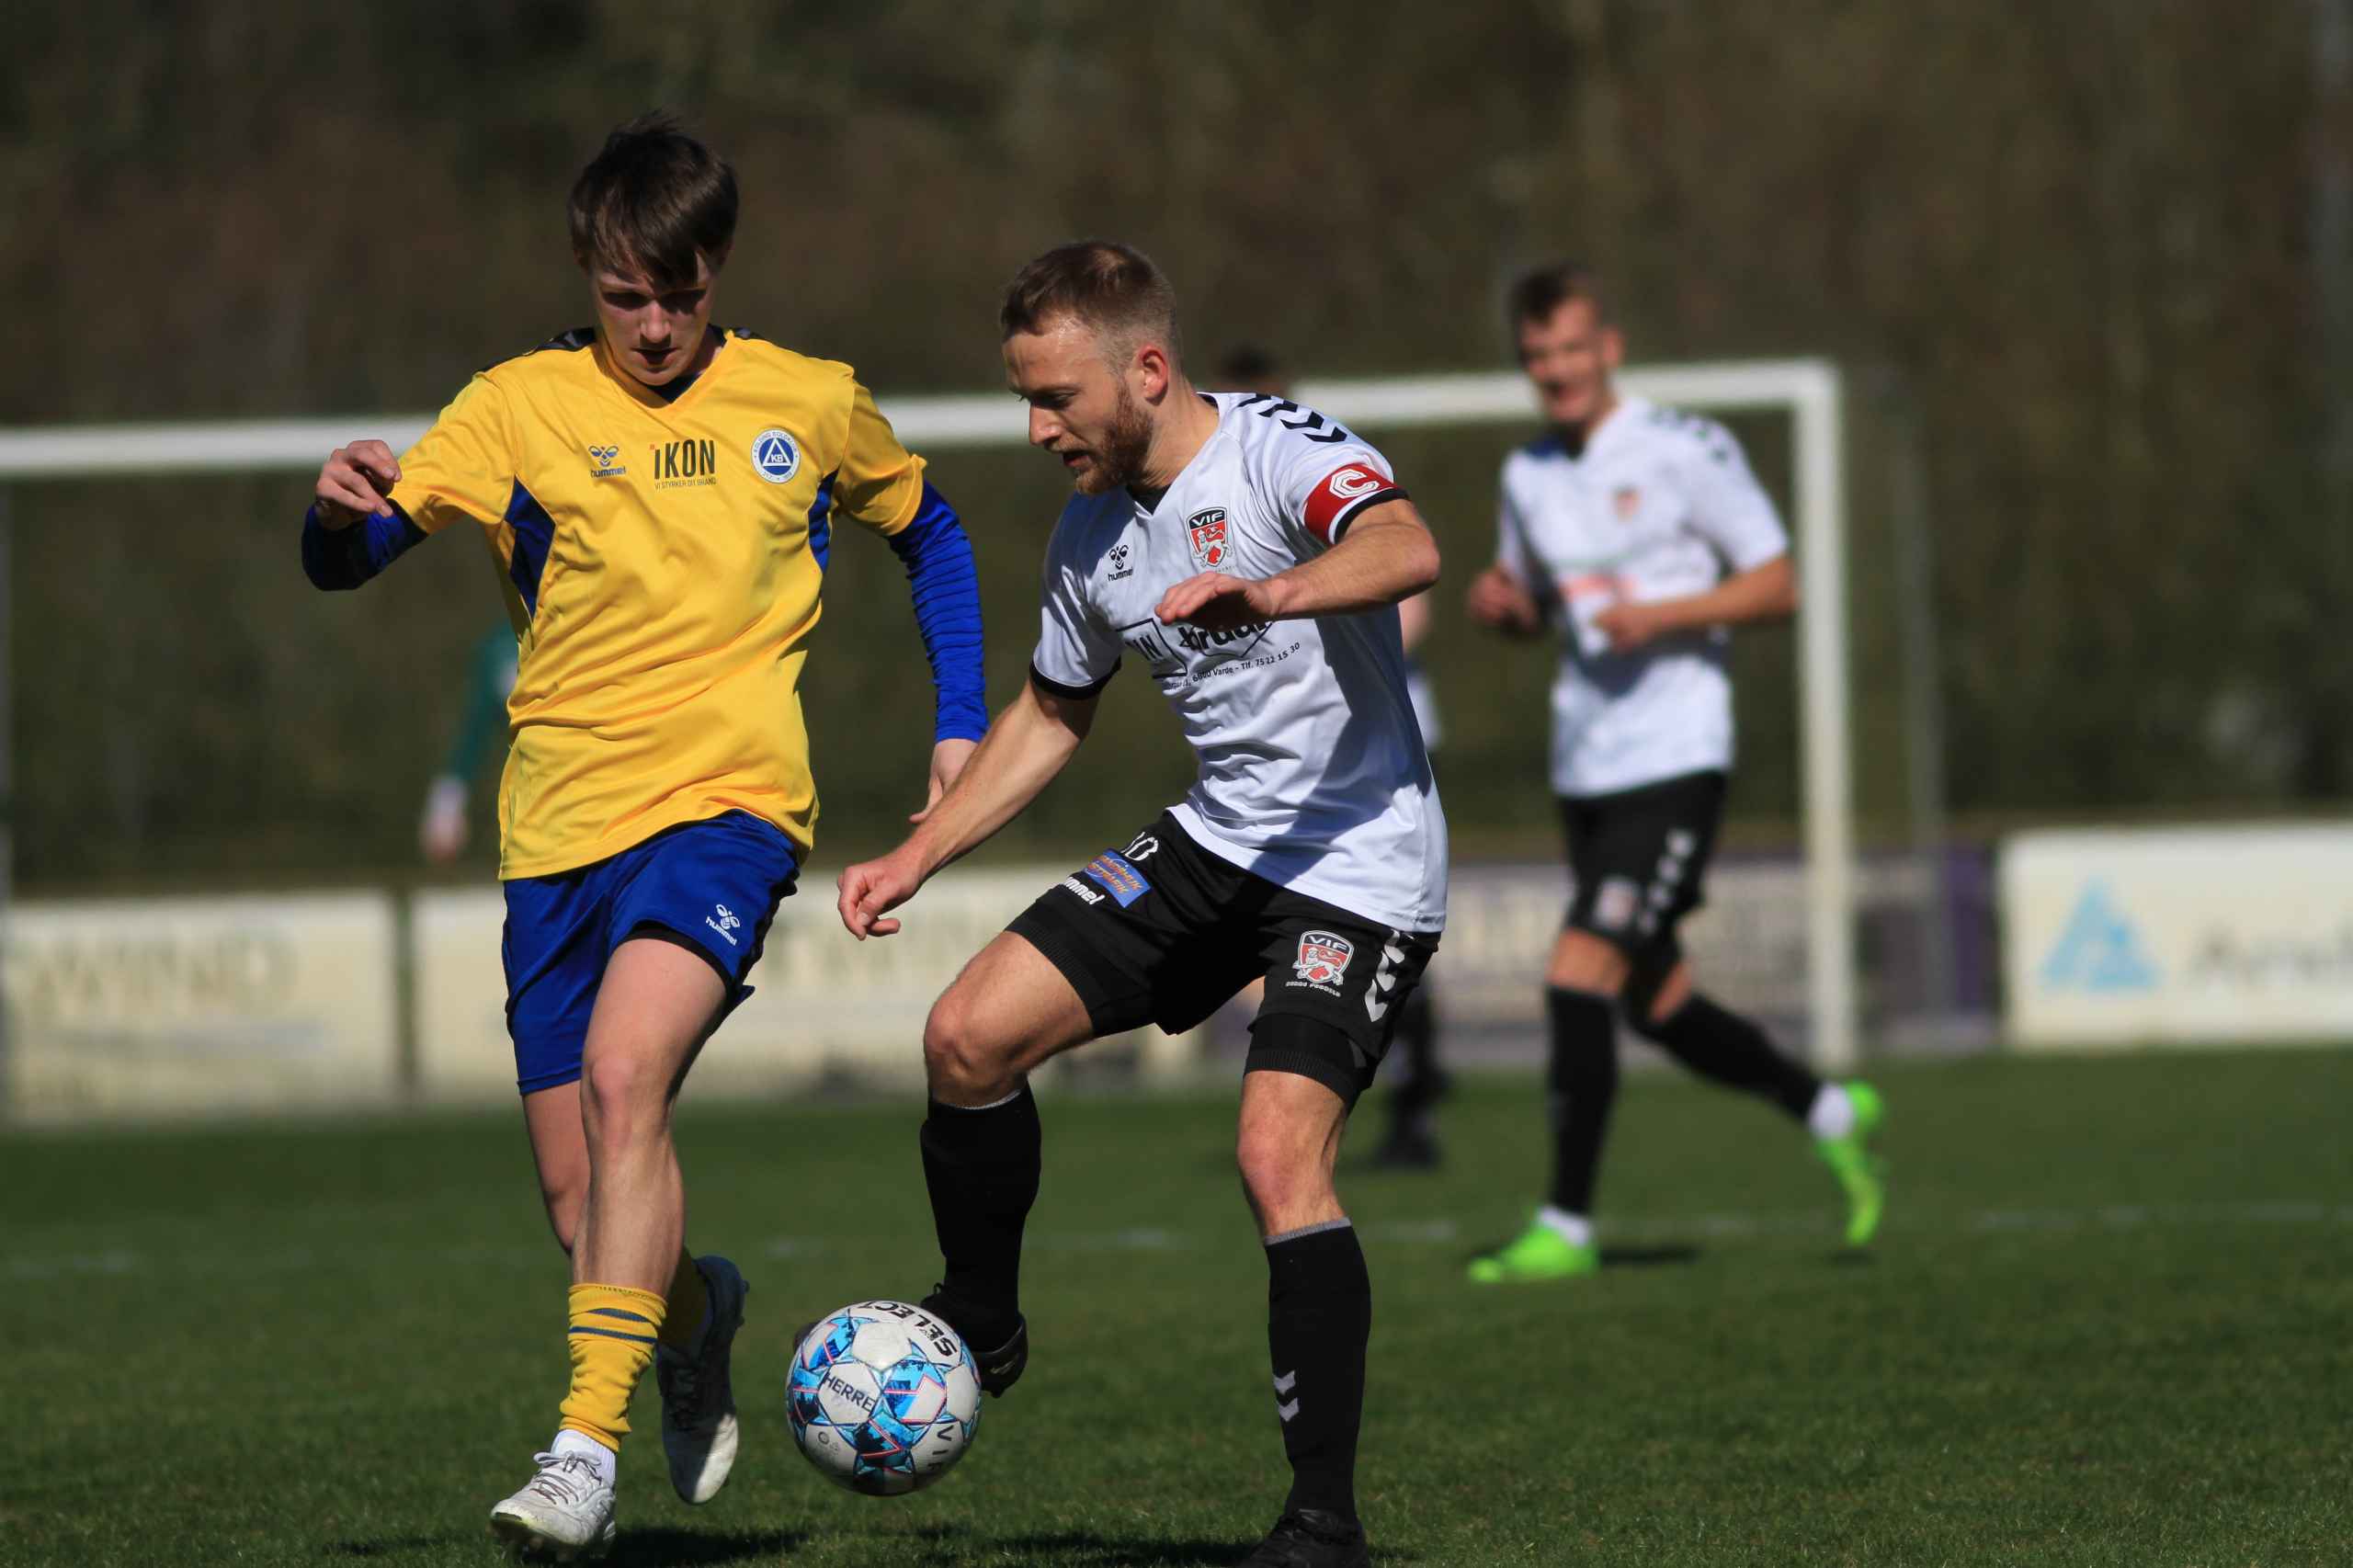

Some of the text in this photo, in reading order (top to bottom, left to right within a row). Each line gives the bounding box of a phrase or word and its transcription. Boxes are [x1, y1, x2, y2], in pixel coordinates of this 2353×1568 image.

[590, 465, 627, 479] hummel
[1329, 469, 1380, 499] C
[1191, 511, 1223, 527] VIF
[1192, 669, 1211, 682] 6800
[1213, 666, 1233, 676] Varde
[1241, 661, 1254, 671] Tlf.
[1256, 659, 1265, 667] 75
[1279, 652, 1289, 661] 15
[1290, 642, 1301, 653] 30
[1065, 876, 1106, 905] mmel
[706, 915, 738, 946] hummel
[1308, 935, 1348, 950] VIF
[857, 1301, 959, 1358] SELECT
[821, 1370, 877, 1413] HERRE
